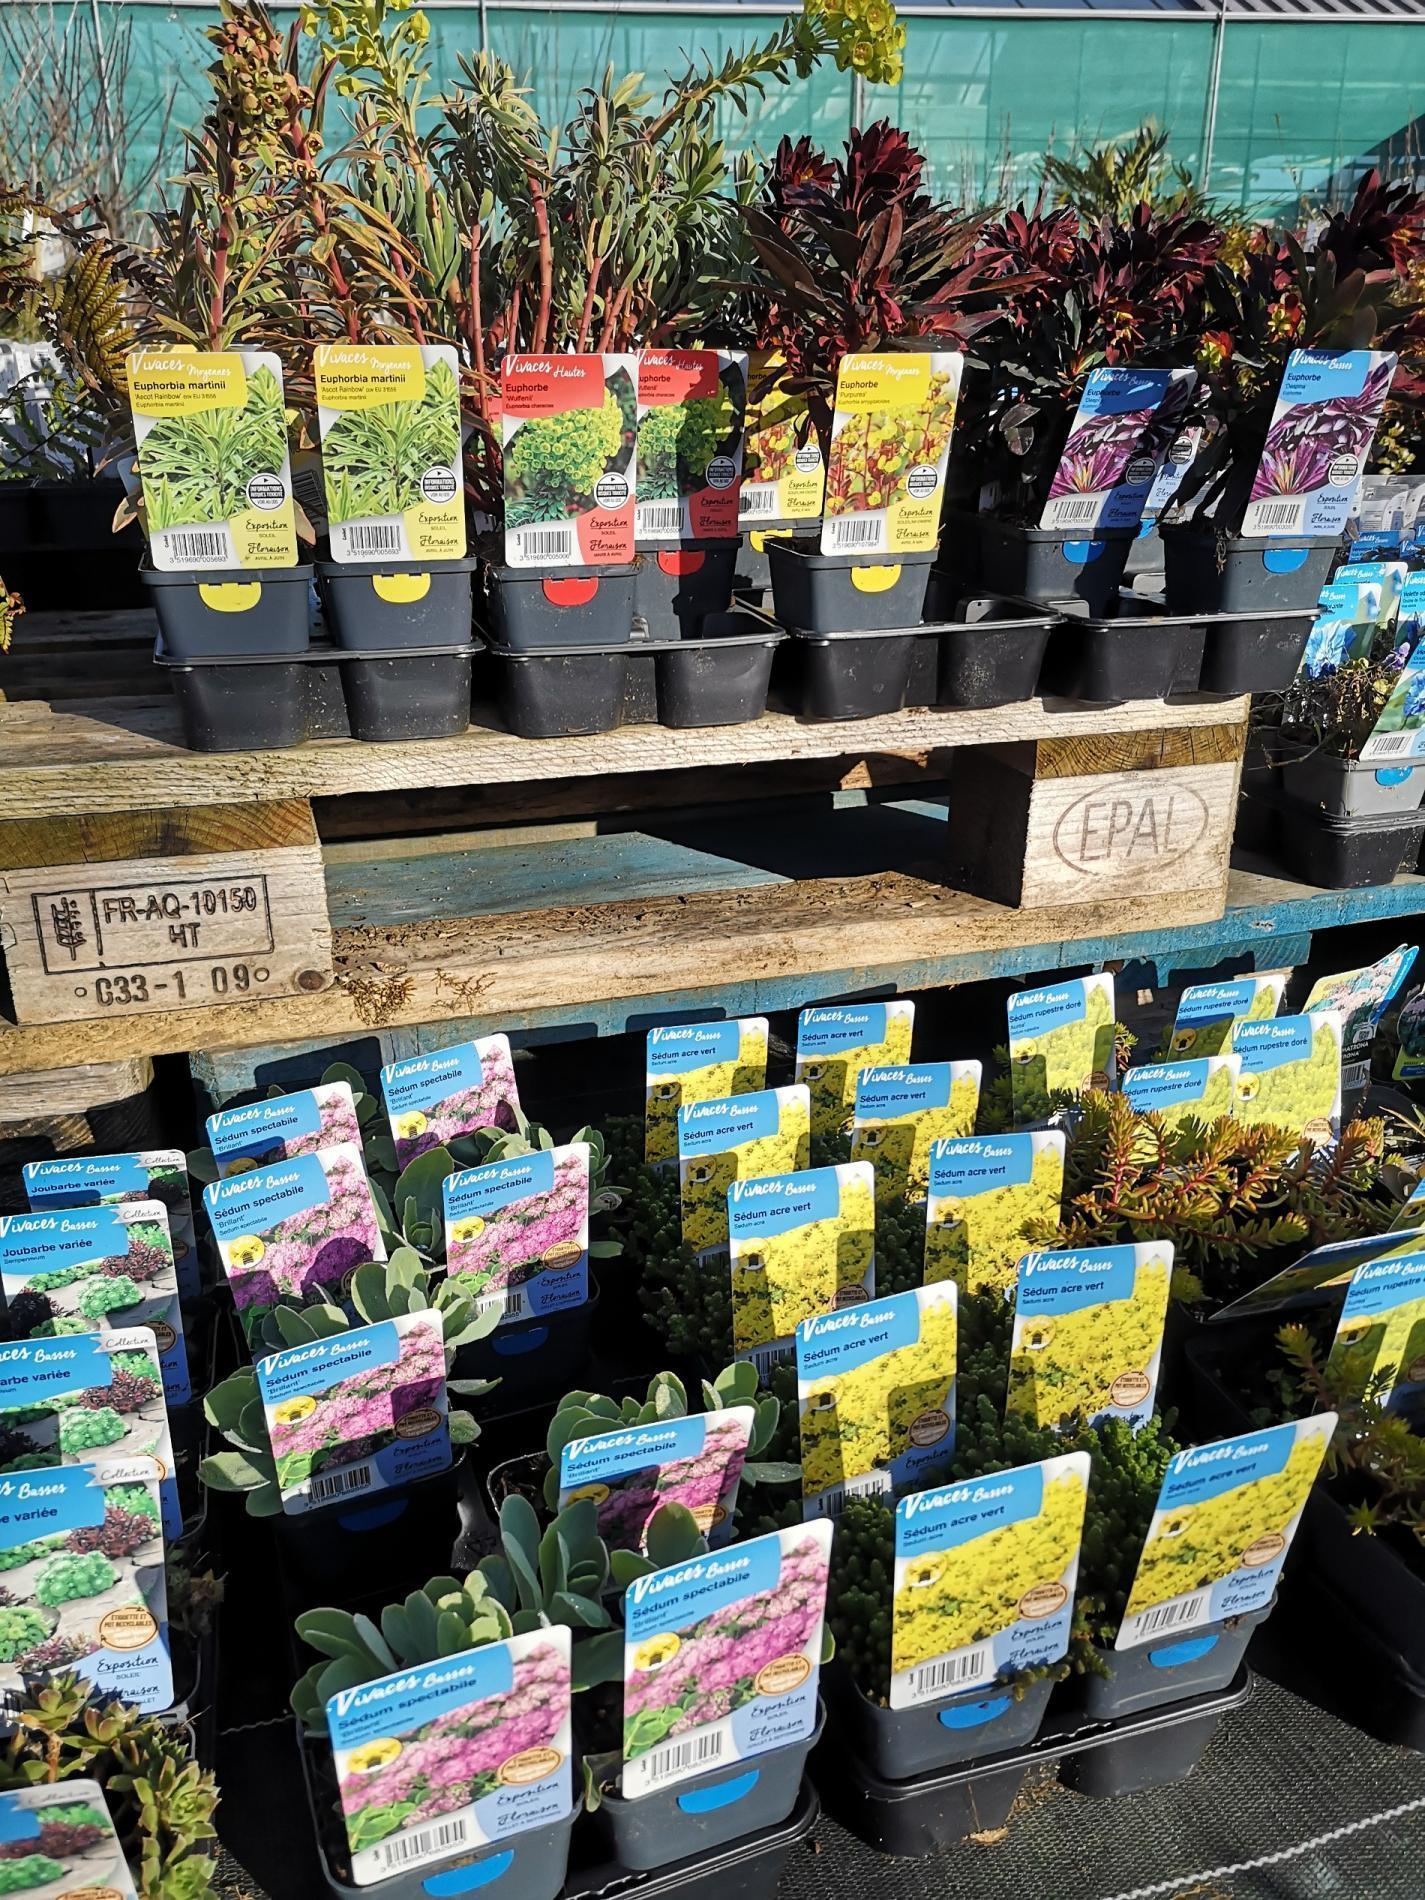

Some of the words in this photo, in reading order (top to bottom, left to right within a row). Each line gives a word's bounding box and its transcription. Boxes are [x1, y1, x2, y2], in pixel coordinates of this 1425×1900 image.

[131, 349, 184, 375] Vivaces
[319, 345, 369, 368] Vivaces
[505, 354, 552, 377] Vivaces
[553, 365, 587, 378] Hautes
[842, 354, 884, 374] Vivaces
[1292, 349, 1329, 368] Vivaces
[134, 382, 185, 391] Euphorbia
[188, 380, 226, 390] martinii
[321, 374, 369, 384] Euphorbia
[371, 373, 406, 383] martinii
[505, 383, 548, 393] Euphorbe
[638, 374, 671, 384] uphorbe
[840, 380, 879, 390] Euphorbe
[1287, 372, 1321, 382] Euphorbe
[418, 512, 458, 525] Exposition
[589, 517, 628, 529] Exposition
[898, 508, 933, 519] Exposition
[246, 519, 288, 532] Exposition
[247, 542, 290, 554] Floraison
[419, 535, 459, 547] Floraison
[589, 539, 628, 551] Floraison
[1079, 795, 1179, 862] EPAL
[102, 887, 257, 924] FR-AQ-10150
[169, 922, 201, 949] HT
[211, 963, 250, 995] 09
[802, 1008, 844, 1026] Vivaces
[1009, 1012, 1034, 1023] Sédum
[1035, 1005, 1064, 1018] rupestre
[1065, 1000, 1082, 1010] doré
[1178, 1005, 1202, 1014] Sédum
[1203, 1000, 1232, 1012] rupestre
[652, 1027, 695, 1045] Vivaces
[802, 1033, 829, 1041] Sédum
[830, 1031, 847, 1039] acre
[849, 1030, 864, 1038] vert
[1232, 1021, 1272, 1041] Vivaces
[651, 1050, 679, 1061] Sédum
[681, 1049, 699, 1057] acre
[700, 1047, 716, 1056] vert
[1232, 1044, 1258, 1054] Sédum
[1259, 1040, 1290, 1051] rupestre
[1290, 1037, 1308, 1047] doré
[385, 1058, 430, 1085] Vivaces
[388, 1081, 418, 1097] Sédum
[420, 1069, 463, 1088] spectabile
[862, 1067, 906, 1087] Vivaces
[860, 1094, 889, 1104] Sédum
[890, 1093, 909, 1102] acre
[910, 1091, 926, 1100] vert
[1150, 1082, 1183, 1094] rupestre
[1184, 1079, 1202, 1089] doré
[210, 1106, 262, 1133] Vivaces
[683, 1102, 729, 1124] Vivaces
[214, 1129, 249, 1145] Sédum
[250, 1116, 299, 1136] spectabile
[683, 1128, 714, 1141] Sédum
[716, 1126, 735, 1136] acre
[737, 1121, 754, 1132] vert
[936, 1138, 984, 1160] Vivaces
[28, 1161, 84, 1180] Vivaces
[86, 1164, 122, 1175] Basses
[144, 1156, 181, 1165] Collection
[934, 1169, 966, 1179] Sédum
[968, 1168, 987, 1176] acre
[988, 1166, 1006, 1175] vert
[31, 1181, 82, 1194] Joubarbe
[84, 1178, 116, 1188] variée
[209, 1174, 264, 1206] Vivaces
[448, 1168, 499, 1193] Vivaces
[448, 1190, 482, 1205] Sédum
[484, 1177, 533, 1196] spectabile
[733, 1180, 785, 1203] Vivaces
[214, 1202, 251, 1220] Sédum
[252, 1185, 305, 1207] spectabile
[733, 1210, 767, 1223] Sédum
[770, 1205, 791, 1217] acre
[792, 1202, 811, 1213] vert
[0, 1215, 60, 1239] Vivaces
[60, 1219, 99, 1233] Basses
[122, 1210, 162, 1220] Collection
[216, 1214, 246, 1230] 'Brillant'
[2, 1244, 56, 1258] Joubarbe
[58, 1239, 93, 1251] variée
[1025, 1252, 1079, 1277] Vivaces
[1022, 1286, 1058, 1298] Sédum
[1060, 1284, 1083, 1294] acre
[1085, 1281, 1105, 1292] vert
[803, 1311, 860, 1343] Vivaces
[34, 1348, 77, 1363] Basses
[105, 1338, 150, 1349] Collection
[803, 1345, 841, 1363] Sédum
[843, 1339, 866, 1352] acre
[869, 1331, 889, 1345] vert
[261, 1345, 329, 1376] Vivaces
[266, 1368, 309, 1388] Sédum
[311, 1349, 373, 1374] spectabile
[32, 1369, 71, 1382] variée
[567, 1433, 636, 1460] Vivaces
[567, 1456, 611, 1472] Sédum
[613, 1441, 677, 1462] spectabile
[17, 1482, 68, 1500] Basses
[100, 1469, 151, 1482] Collection
[16, 1507, 58, 1522] variée
[902, 1487, 972, 1520] Vivaces
[903, 1521, 948, 1540] Sédum
[950, 1513, 978, 1529] acre
[980, 1505, 1006, 1521] vert
[631, 1564, 705, 1604] Vivaces
[631, 1595, 681, 1621] Sédum
[683, 1571, 751, 1602] spectabile
[1011, 1619, 1063, 1642] Exposition
[97, 1655, 159, 1674] Exposition
[335, 1674, 422, 1717] Vivaces
[338, 1705, 394, 1731] Sédum
[398, 1676, 477, 1710] spectabile
[751, 1694, 807, 1718] Exposition
[749, 1718, 804, 1742] Floraison
[496, 1780, 560, 1806] Exposition
[497, 1801, 560, 1828] Floraison
